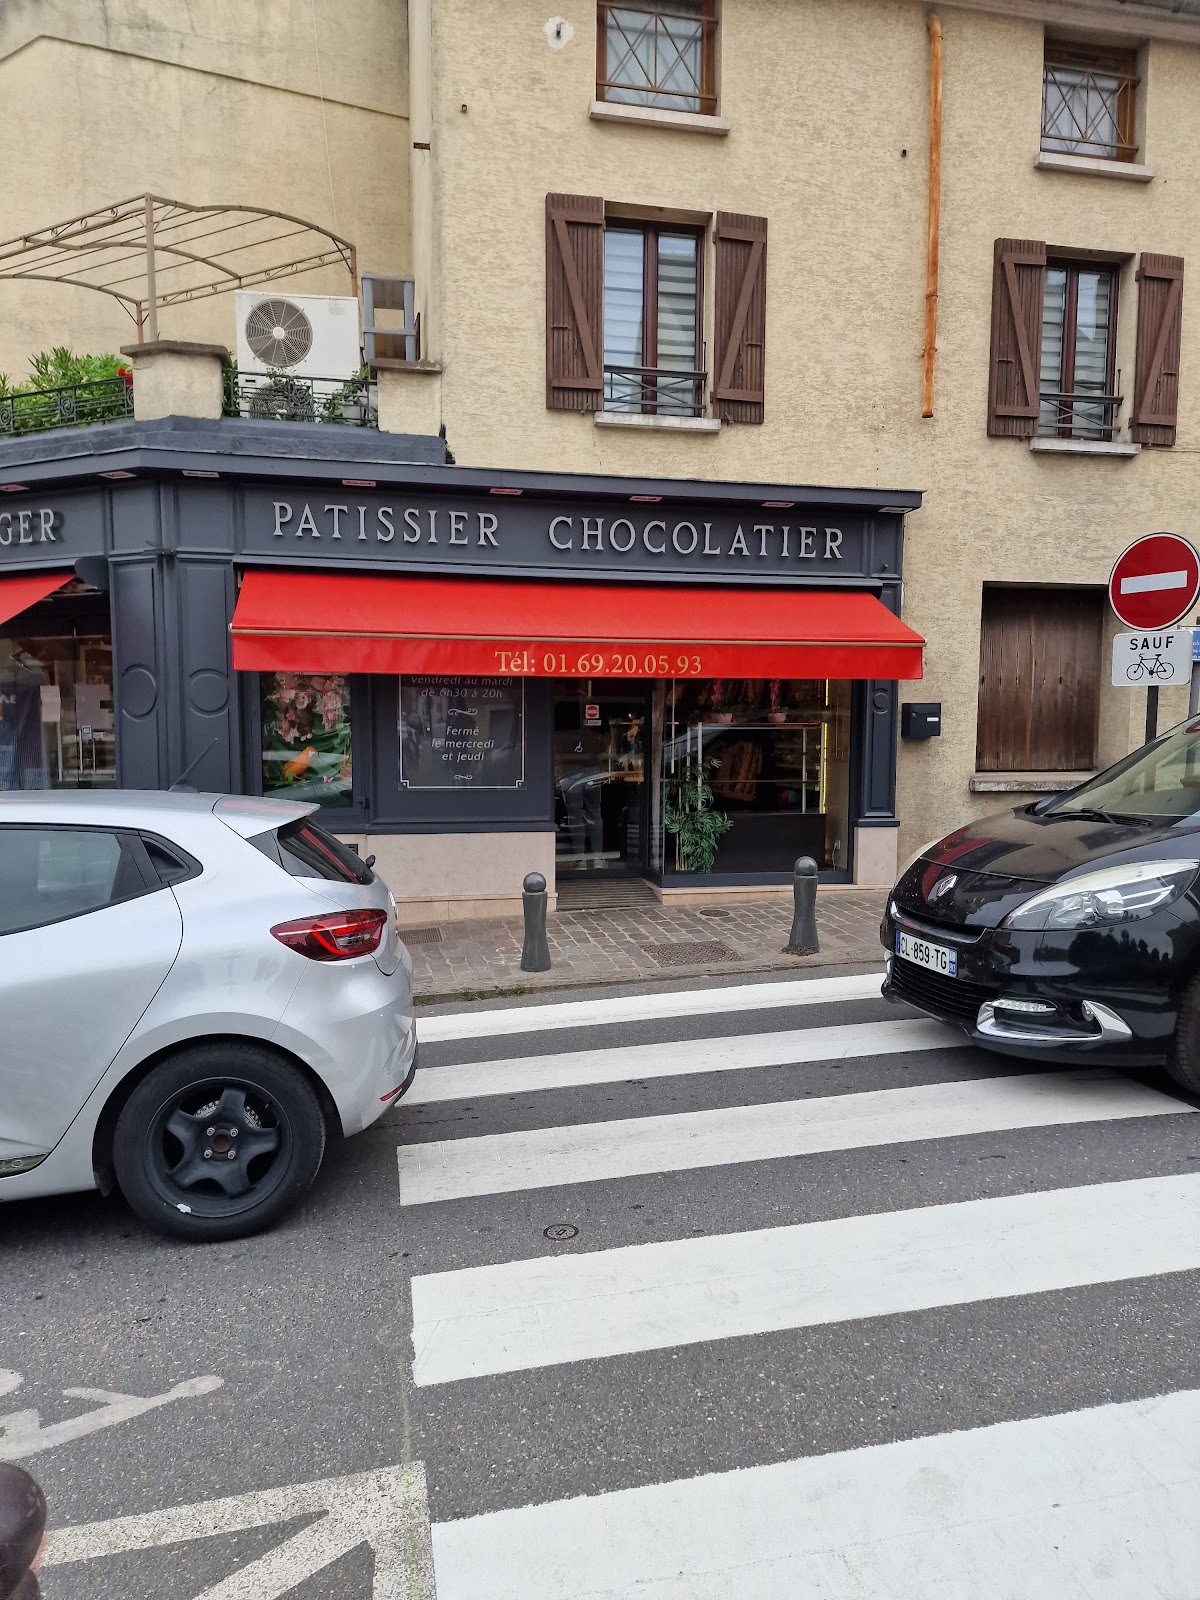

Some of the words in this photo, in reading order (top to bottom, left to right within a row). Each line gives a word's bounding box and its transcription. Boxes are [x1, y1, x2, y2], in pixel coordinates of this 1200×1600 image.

[272, 501, 499, 546] PATISSIER
[549, 516, 843, 559] CHOCOLATIER
[1129, 635, 1174, 651] SAUF
[494, 651, 536, 672] Tél:
[543, 653, 702, 675] 01.69.20.05.93
[411, 675, 461, 685] vendredi
[464, 677, 478, 685] au
[481, 676, 513, 686] mardi
[439, 688, 468, 698] 6h30
[482, 688, 503, 698] 20h
[446, 725, 480, 736] Fermé
[431, 738, 442, 748] le
[445, 739, 495, 749] mercredi
[441, 752, 453, 761] et
[456, 752, 485, 763] jeudi
